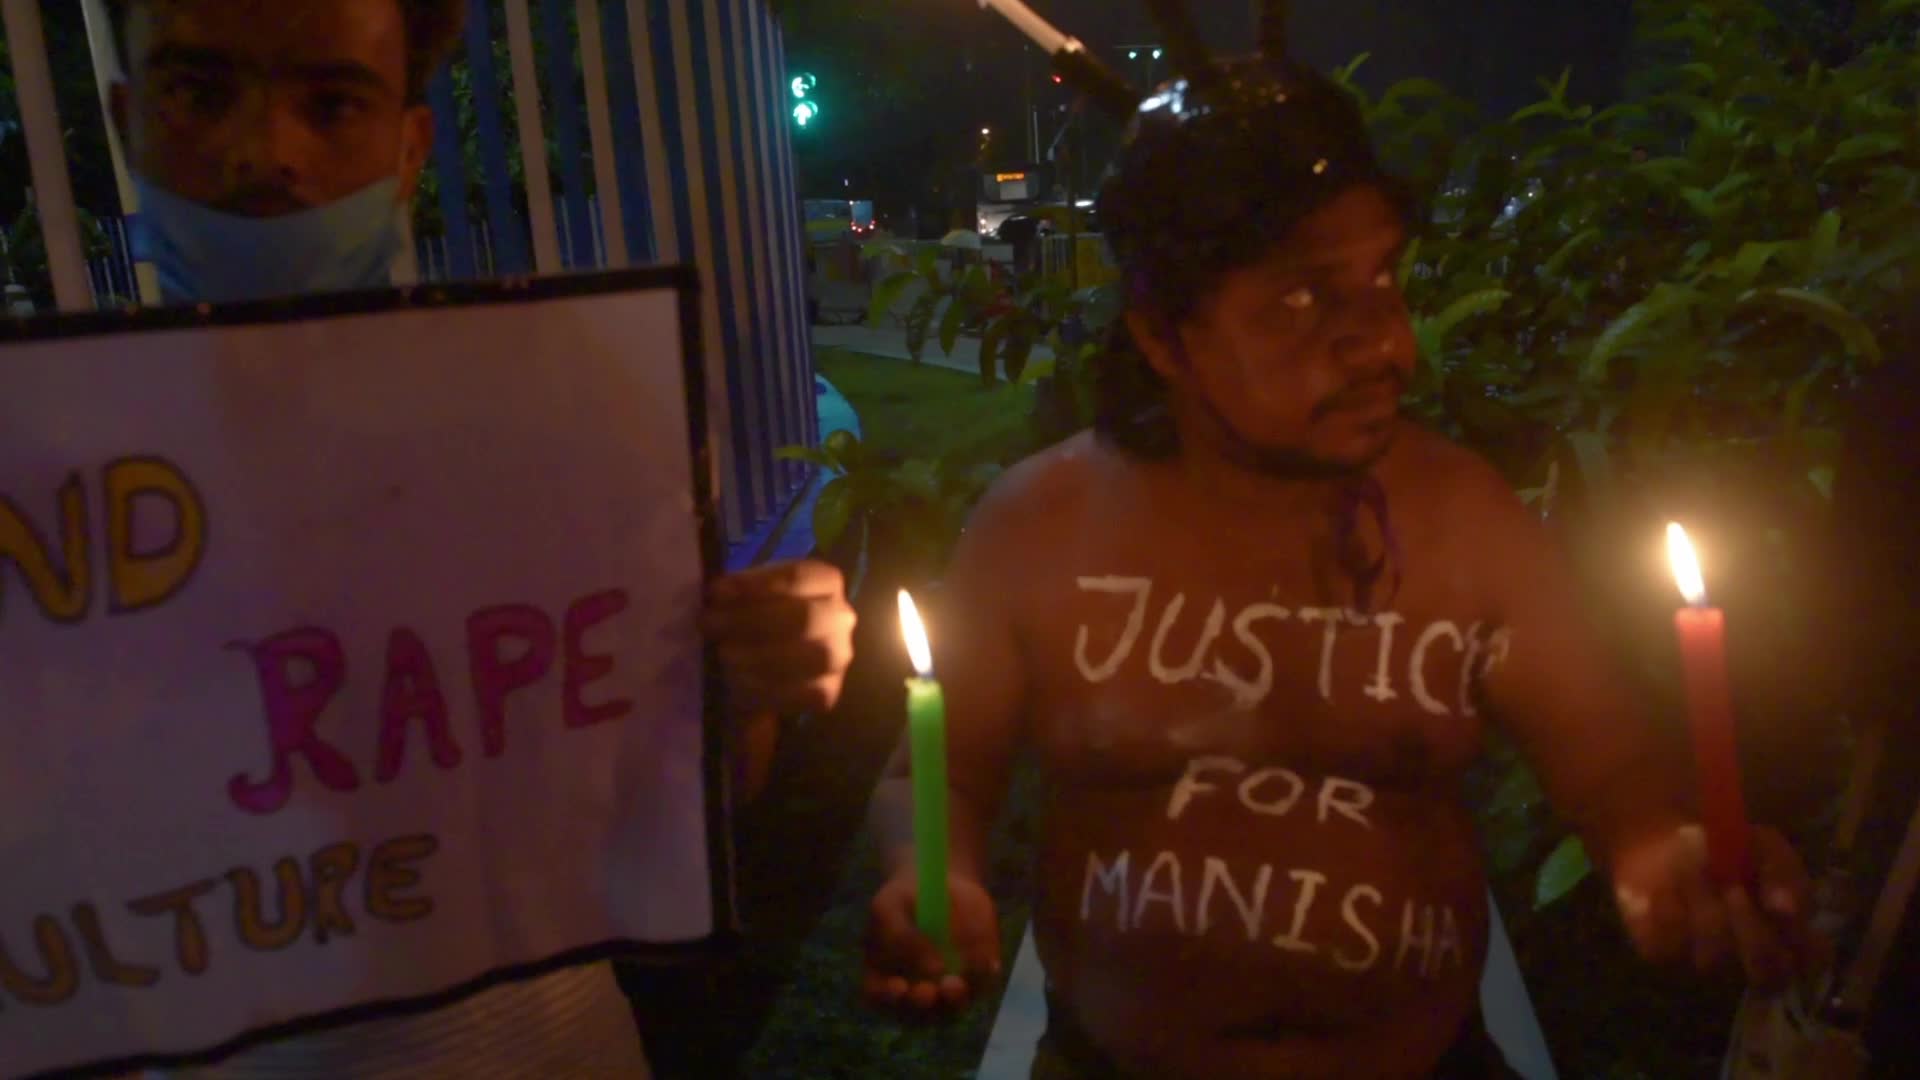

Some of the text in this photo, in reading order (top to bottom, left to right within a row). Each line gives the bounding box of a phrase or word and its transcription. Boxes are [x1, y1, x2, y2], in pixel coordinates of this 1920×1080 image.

[0, 455, 207, 623] ND
[224, 588, 632, 813] RAPE
[1166, 756, 1376, 829] FOR
[0, 834, 438, 1008] ULTURE
[1080, 850, 1464, 977] MANISHA
